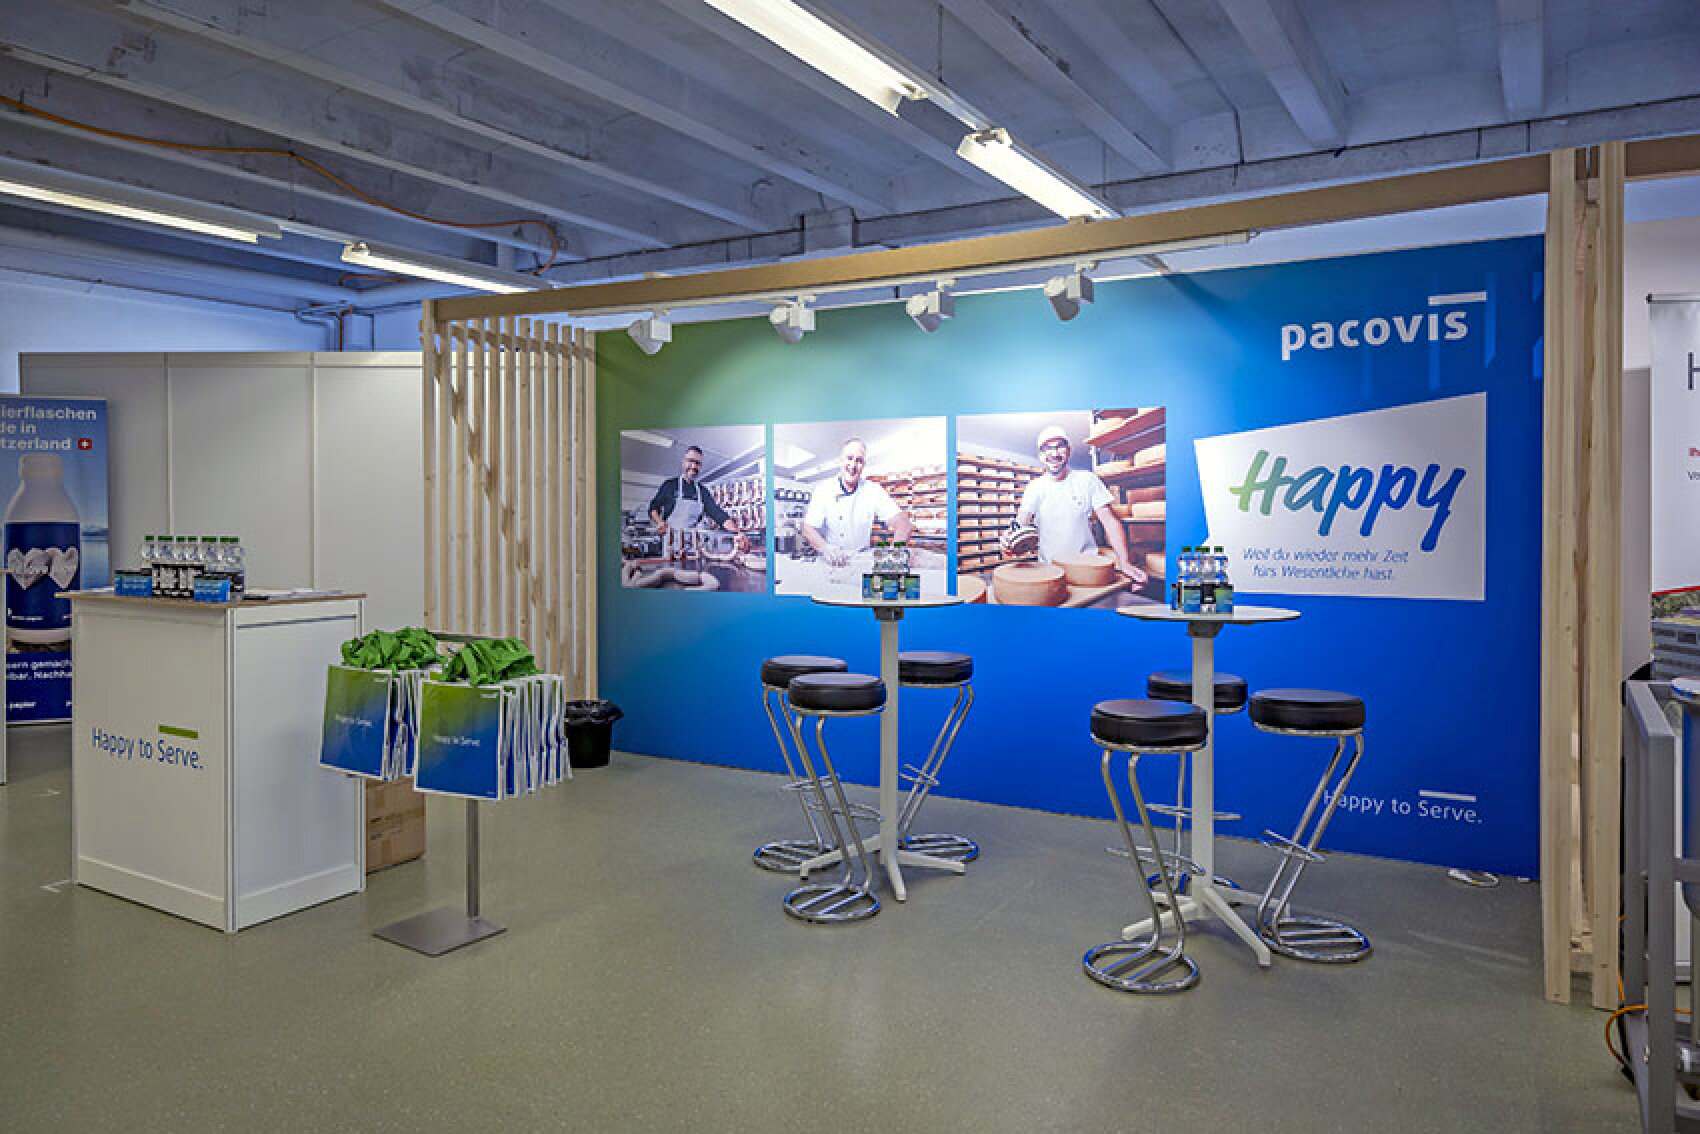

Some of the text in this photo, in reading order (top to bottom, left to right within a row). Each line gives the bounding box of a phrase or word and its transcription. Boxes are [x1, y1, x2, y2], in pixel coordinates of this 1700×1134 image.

[1281, 311, 1469, 361] pacovis
[1229, 450, 1468, 552] Happy
[1273, 547, 1290, 561] du
[92, 727, 205, 770] Happy to Serve.
[1323, 789, 1483, 825] Happy to Serve.
